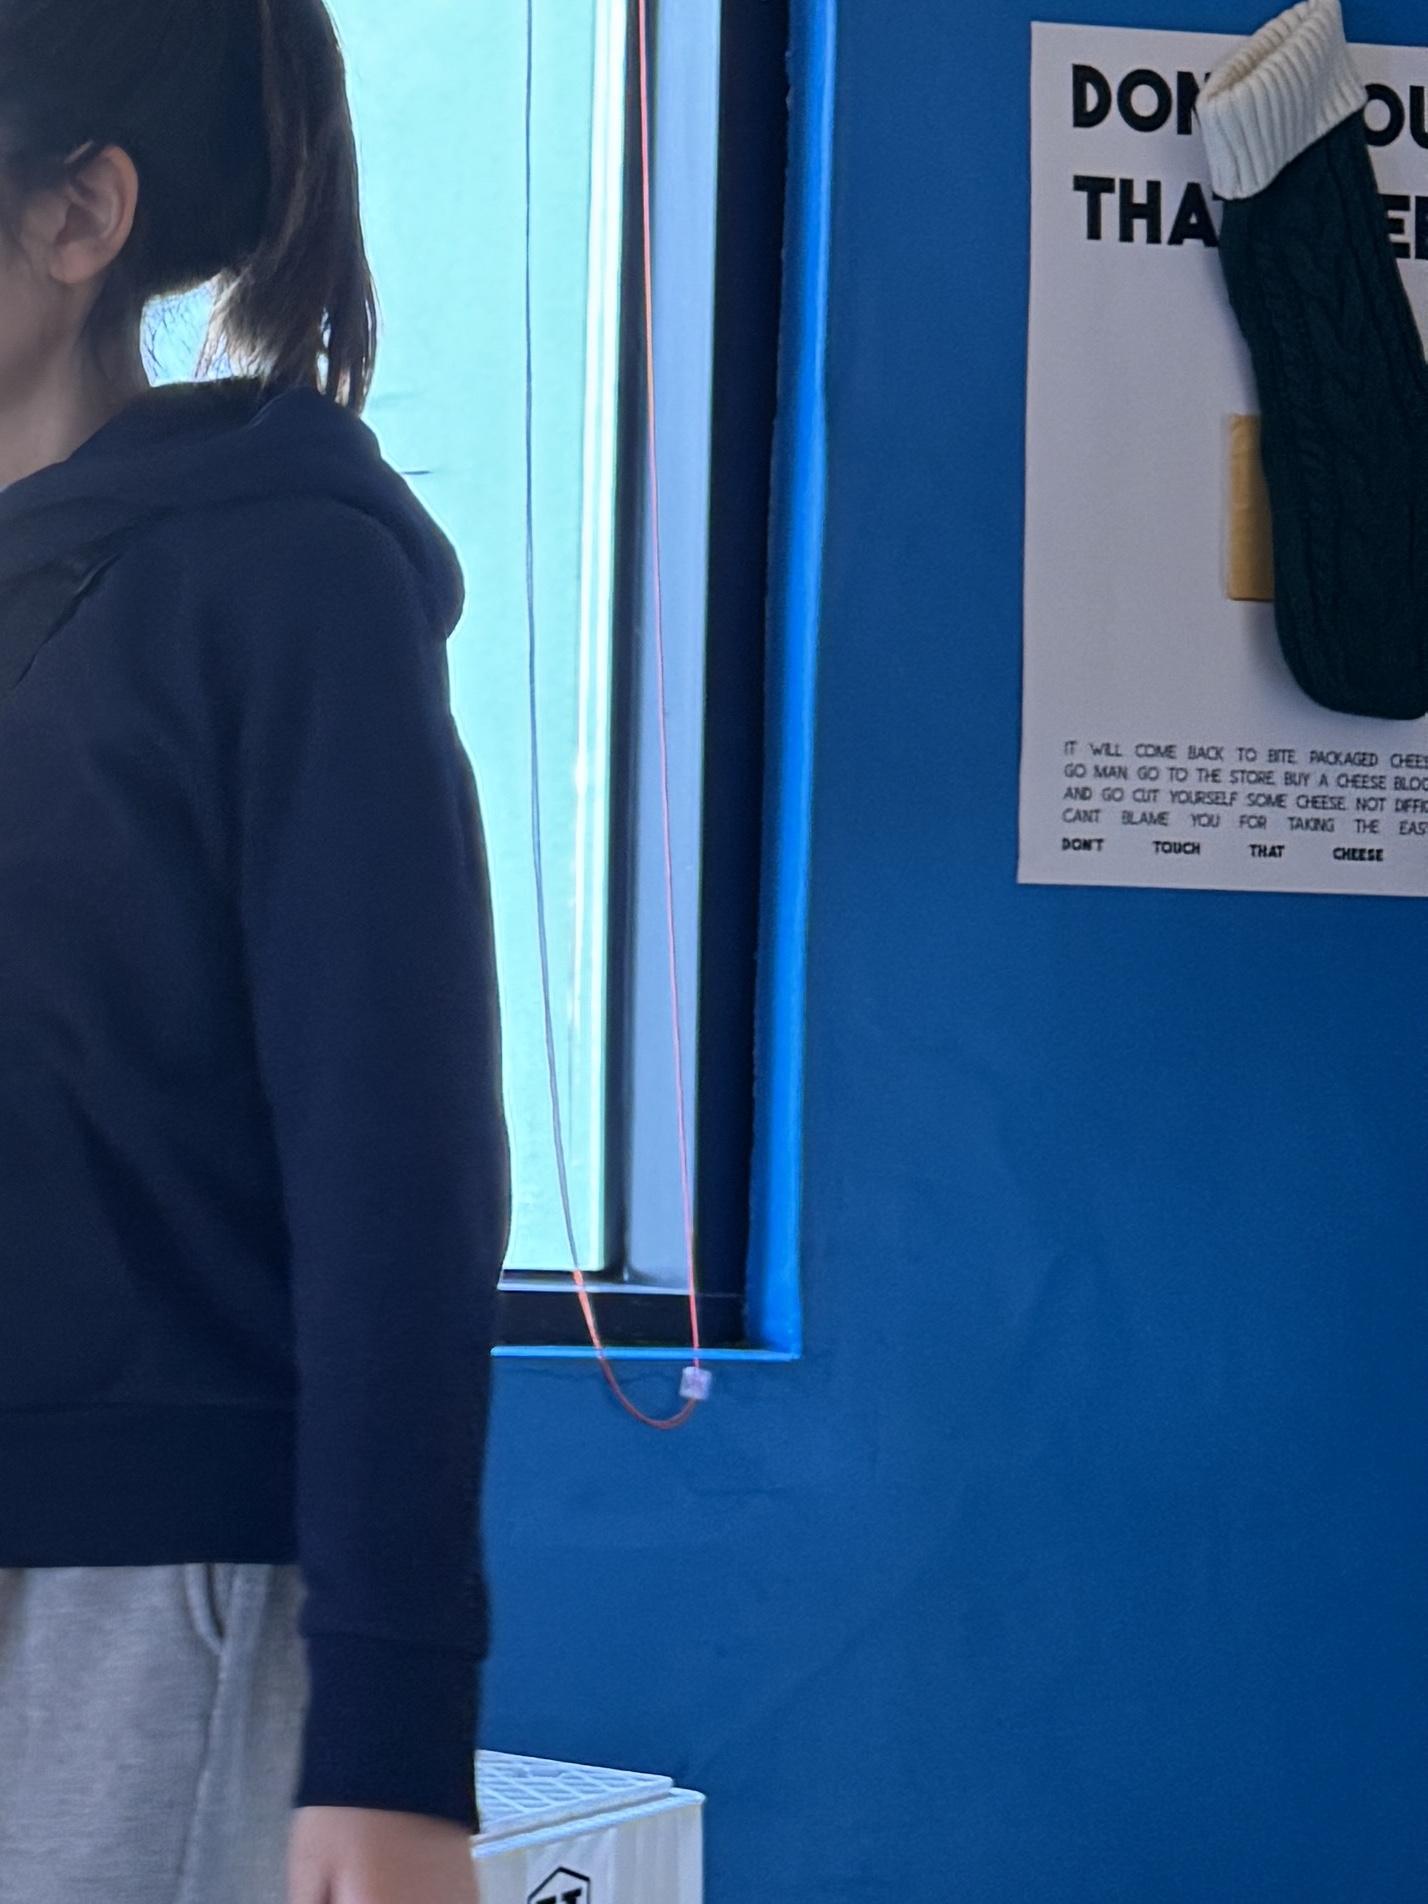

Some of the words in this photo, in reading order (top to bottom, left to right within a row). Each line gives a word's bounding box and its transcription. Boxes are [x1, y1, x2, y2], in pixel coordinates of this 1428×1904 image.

[1073, 175, 1223, 248] THA
[1064, 740, 1077, 756] IT
[1090, 742, 1122, 757] WILL
[1135, 743, 1178, 759] COME
[1188, 746, 1224, 761] BACK
[1237, 747, 1258, 762] TO
[1268, 748, 1296, 764] BITE
[1309, 750, 1378, 767] PACKAGED
[1064, 763, 1087, 779] GO
[1094, 765, 1128, 780] MAN
[1136, 766, 1160, 781] GO
[1168, 767, 1188, 782] TO
[1197, 768, 1222, 783] THE
[1229, 770, 1275, 786] STORE
[1284, 771, 1311, 787] BUY
[1318, 773, 1329, 788] A
[1336, 773, 1387, 791] CHEESE
[1063, 786, 1093, 801] AND
[1102, 787, 1125, 802] GO
[1132, 789, 1160, 803] CUT
[1169, 790, 1238, 807] YOURSELF
[1247, 792, 1288, 809] SOME
[1296, 794, 1347, 811] CHEESE
[1356, 796, 1386, 812] NOT
[1121, 810, 1170, 826] BLAME
[1191, 813, 1221, 828] YOU
[1239, 814, 1267, 830] FOR
[1288, 816, 1335, 833] TAKING
[1356, 819, 1380, 834] THE
[1152, 841, 1201, 855] TOUCH
[1249, 844, 1285, 858] THAT
[1332, 847, 1384, 862] CHEESE
